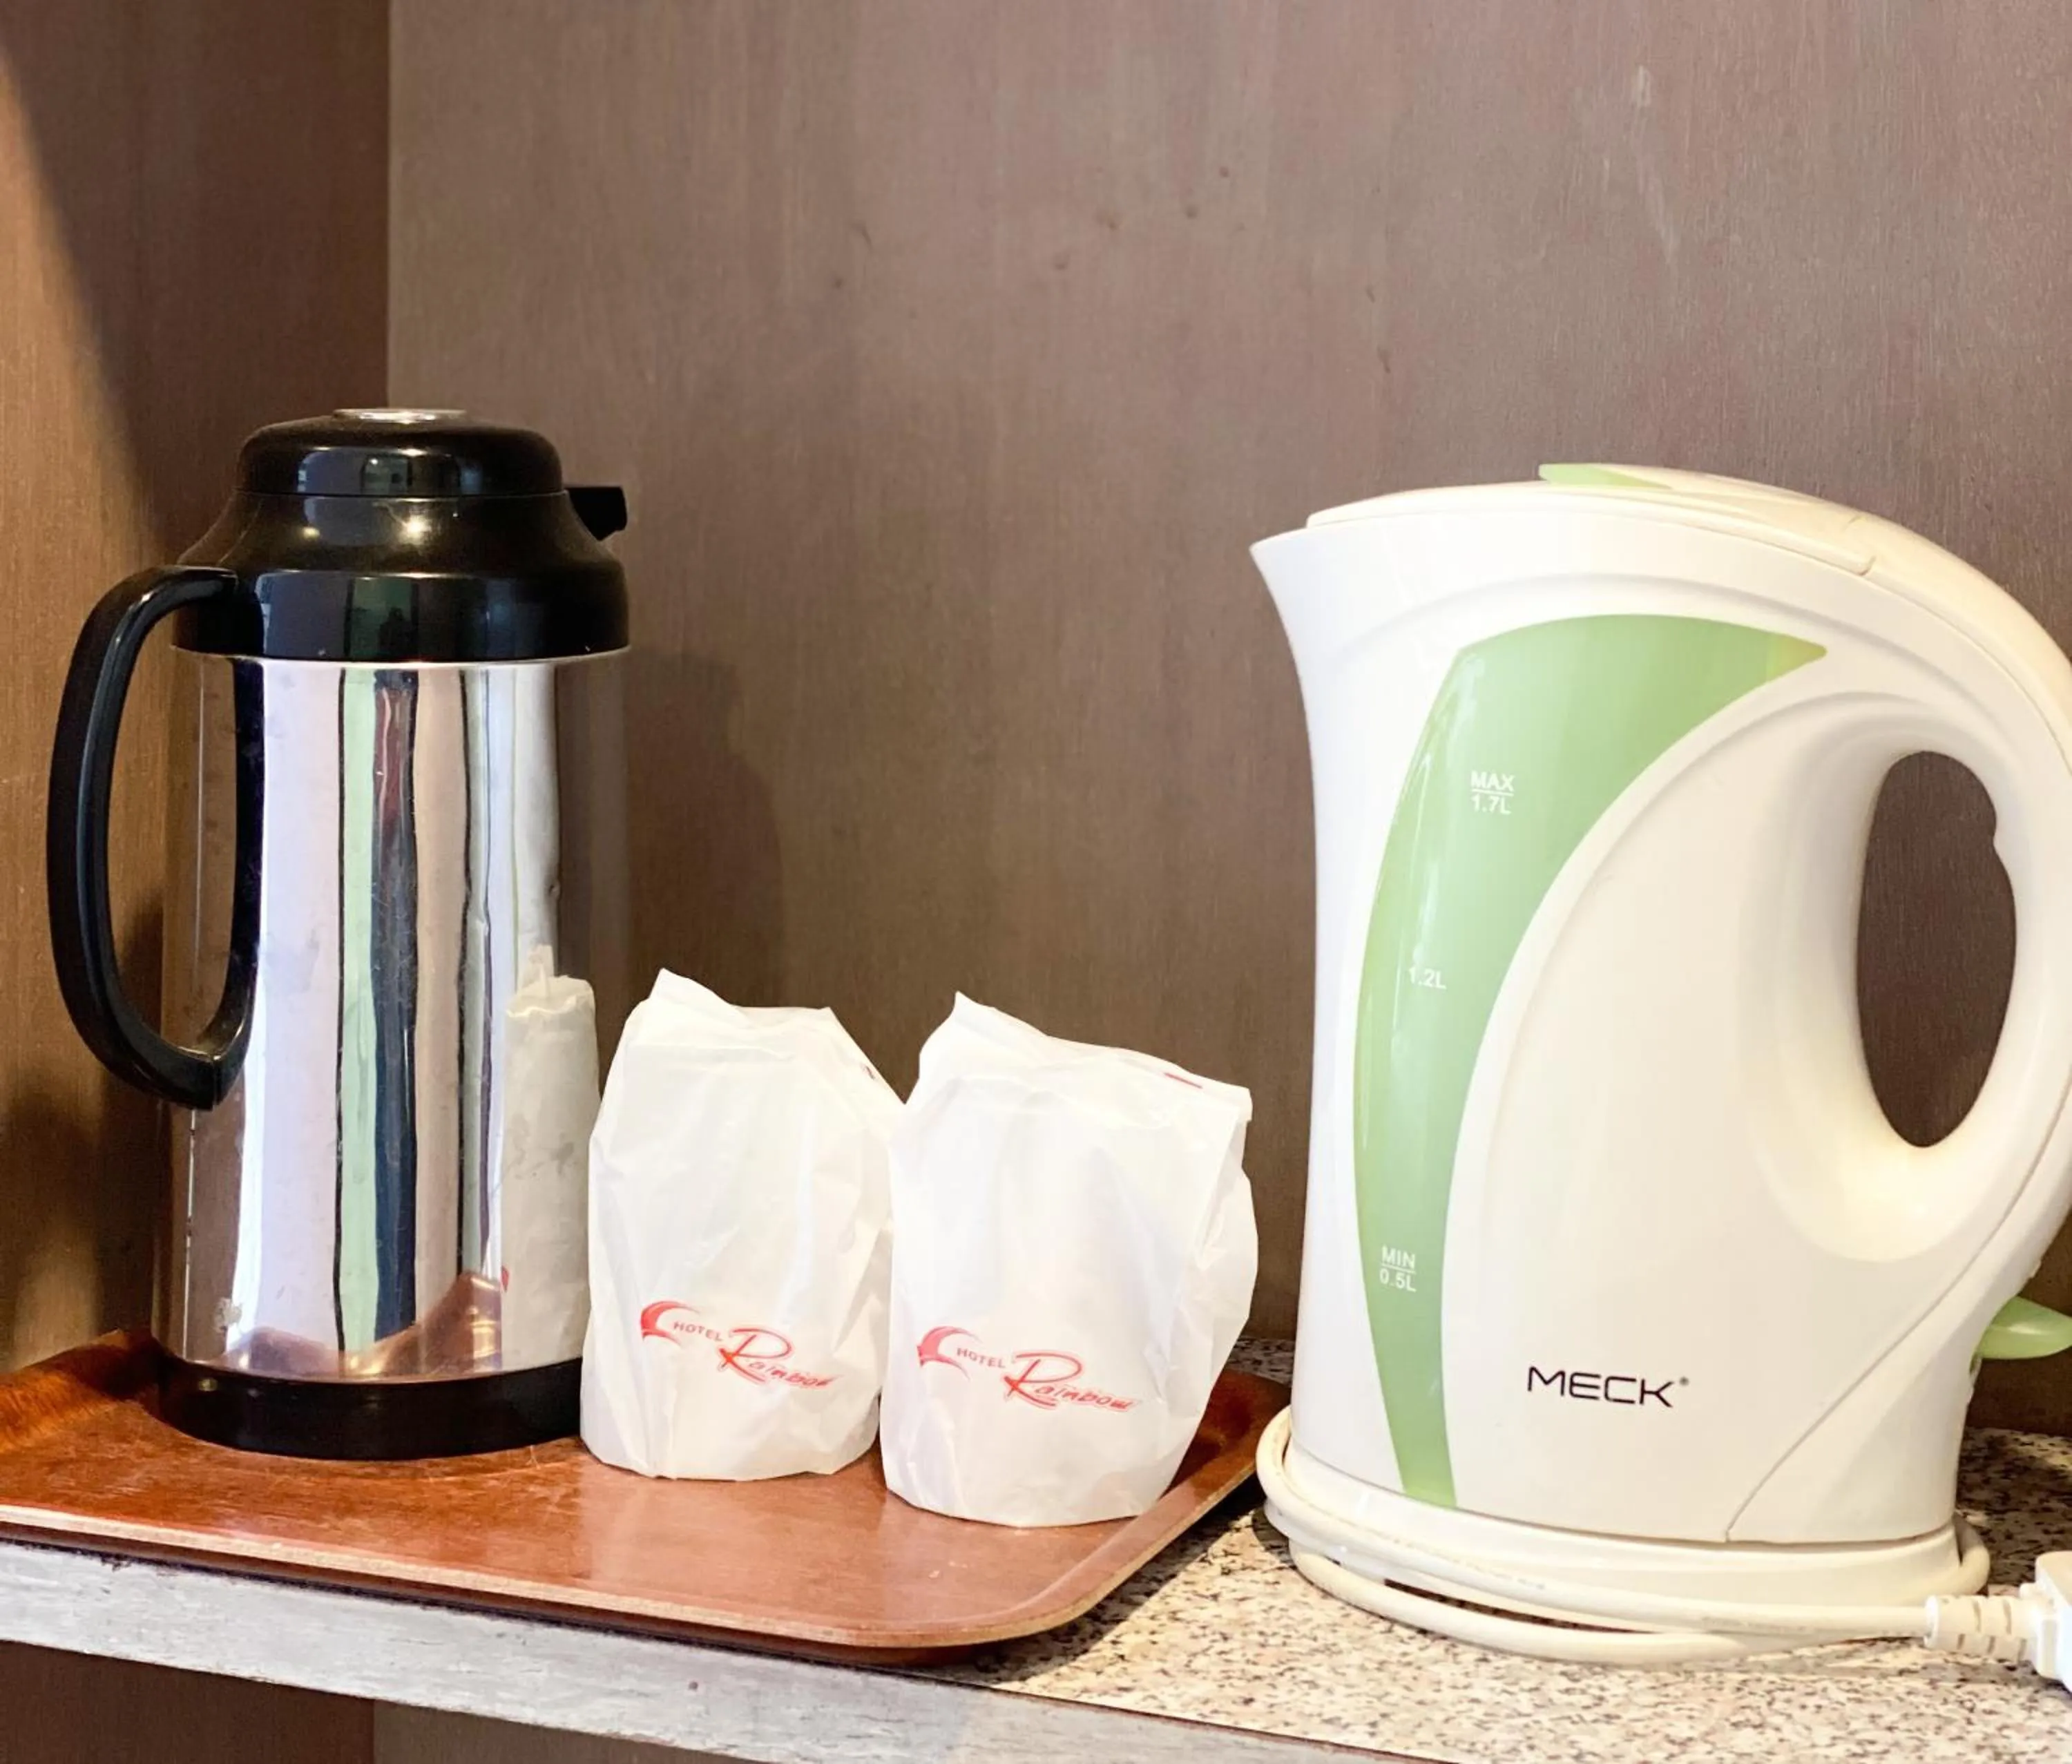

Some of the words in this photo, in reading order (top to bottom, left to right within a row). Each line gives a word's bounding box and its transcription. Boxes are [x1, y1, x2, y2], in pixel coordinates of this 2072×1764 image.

[1470, 770, 1515, 792] MAX
[1470, 794, 1512, 815] 1.7L
[1408, 967, 1447, 990] 1.2L
[1381, 1245, 1416, 1269] MIN
[1379, 1268, 1417, 1292] 0.5L
[673, 1321, 724, 1342] HOTEL
[957, 1347, 1006, 1369] HOTEL
[1003, 1351, 1135, 1411] Rainbow
